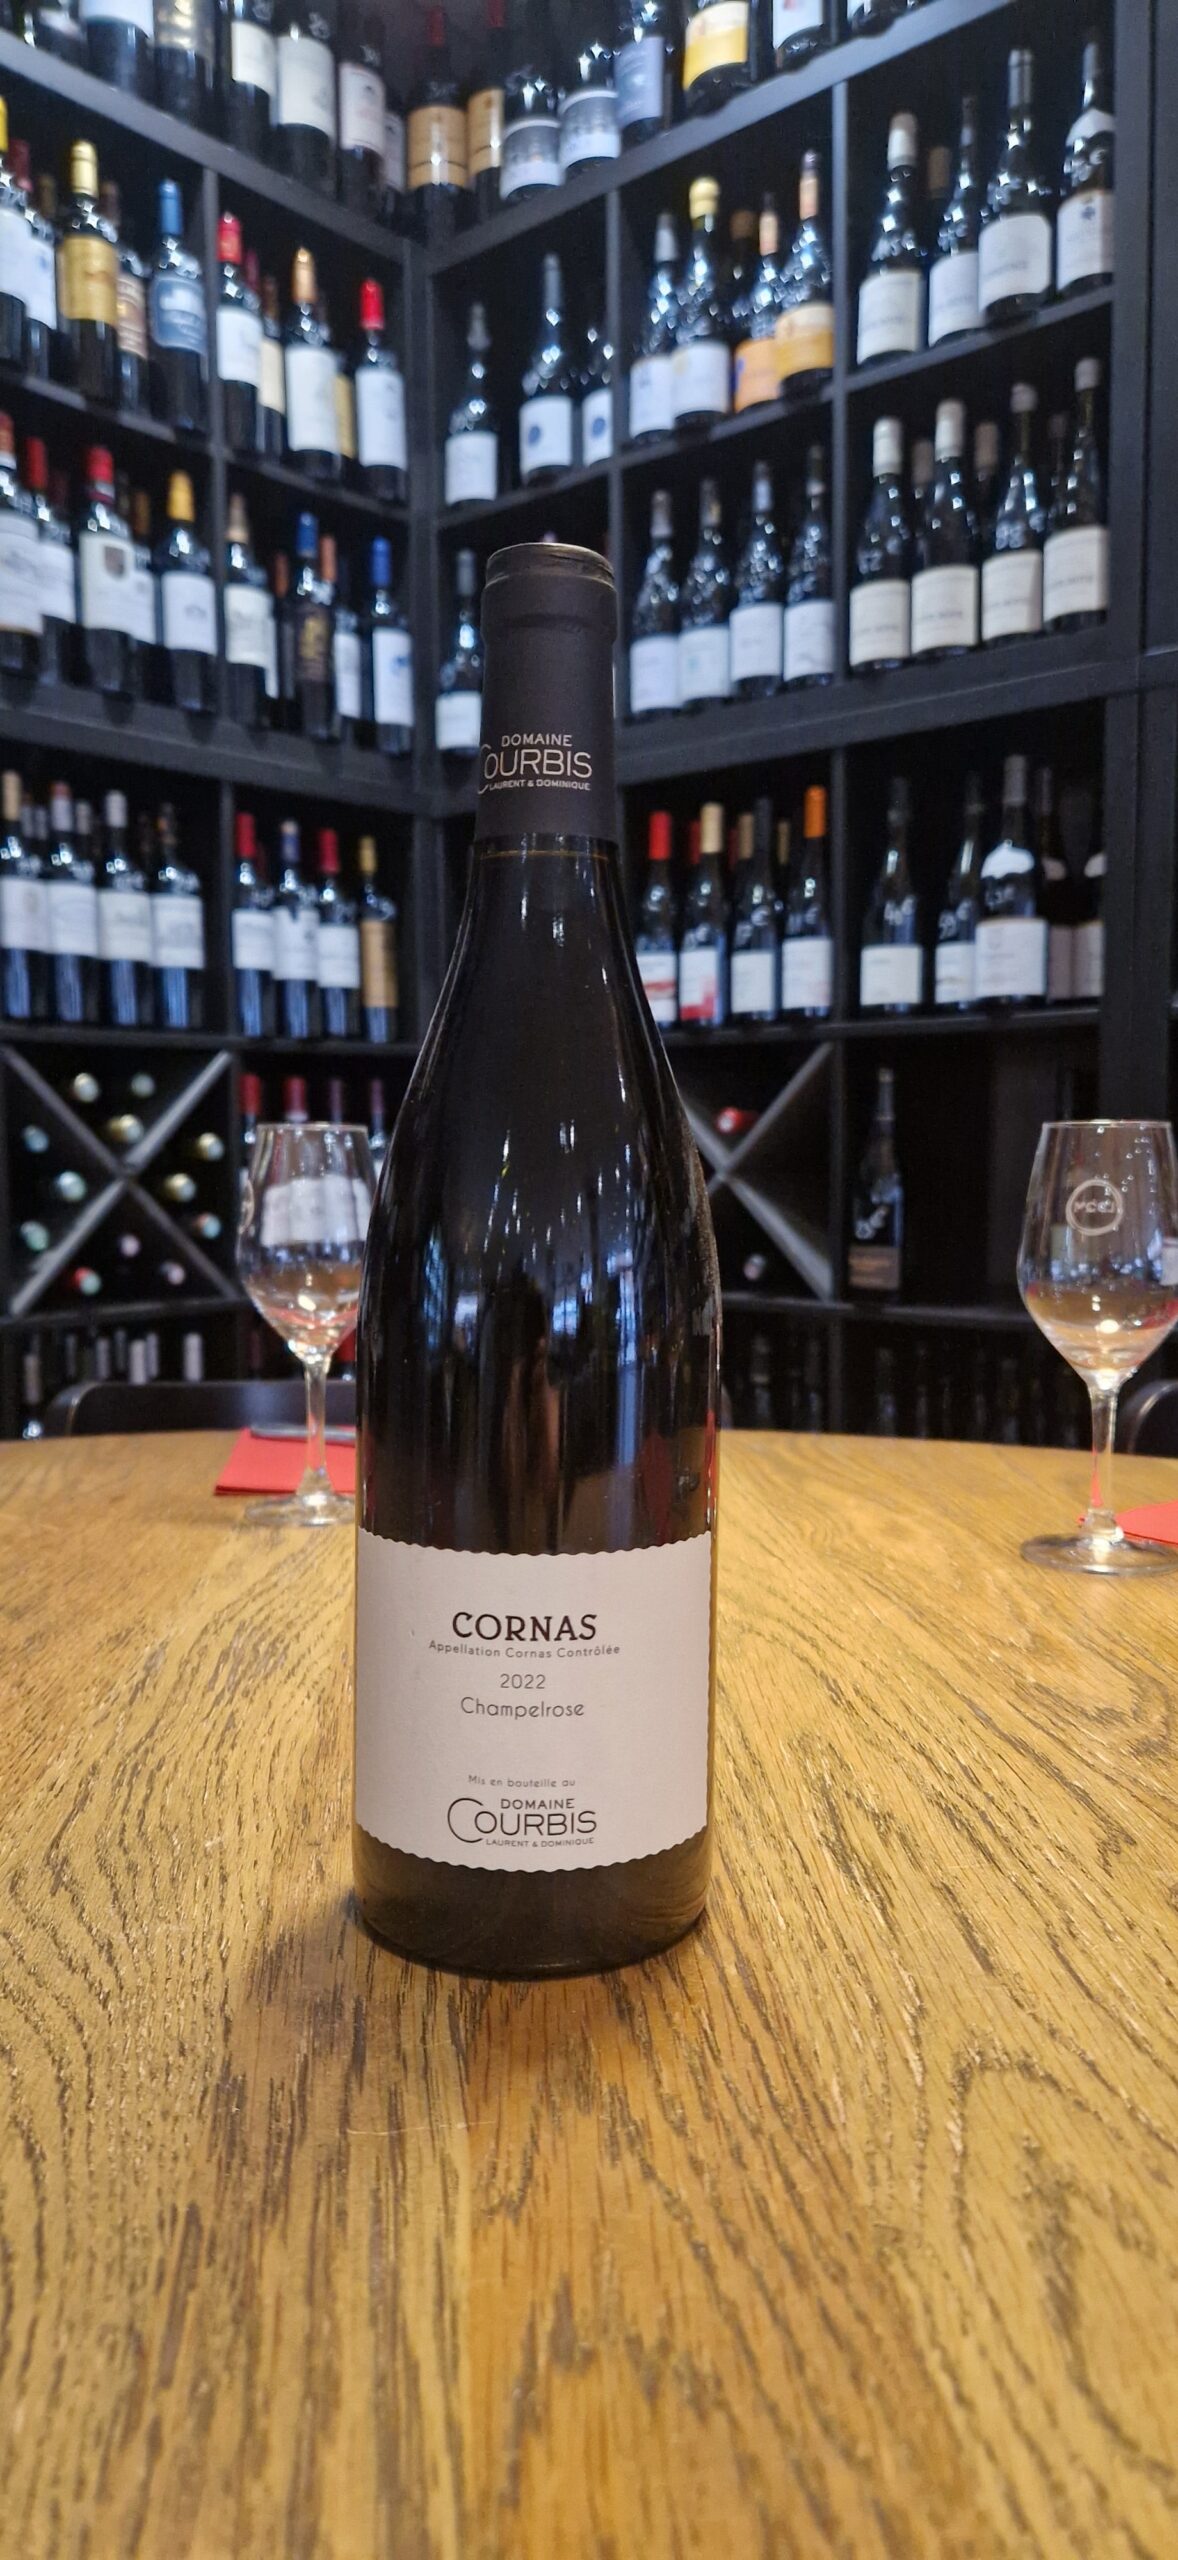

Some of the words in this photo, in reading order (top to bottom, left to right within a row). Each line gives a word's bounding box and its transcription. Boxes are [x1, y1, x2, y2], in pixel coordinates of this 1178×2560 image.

[501, 733, 572, 747] DOMAINE
[489, 780, 524, 790] LAURENT
[536, 778, 591, 791] DOMINIQUE
[452, 1611, 598, 1642] CORNAS
[428, 1640, 500, 1657] Appellation
[505, 1648, 552, 1658] Cornas
[556, 1644, 621, 1658] Contrôlée
[499, 1673, 546, 1690] 2022
[460, 1696, 585, 1720] Champelrose
[467, 1775, 486, 1786] Mis
[489, 1778, 504, 1787] en
[507, 1778, 558, 1788] bouteille
[562, 1778, 576, 1788] au
[500, 1798, 575, 1810] DOMAINE
[447, 1797, 598, 1843] COURBIS
[485, 1838, 530, 1848] LAURENT
[531, 1839, 538, 1848] &
[540, 1837, 595, 1848] DOMINIQUE
